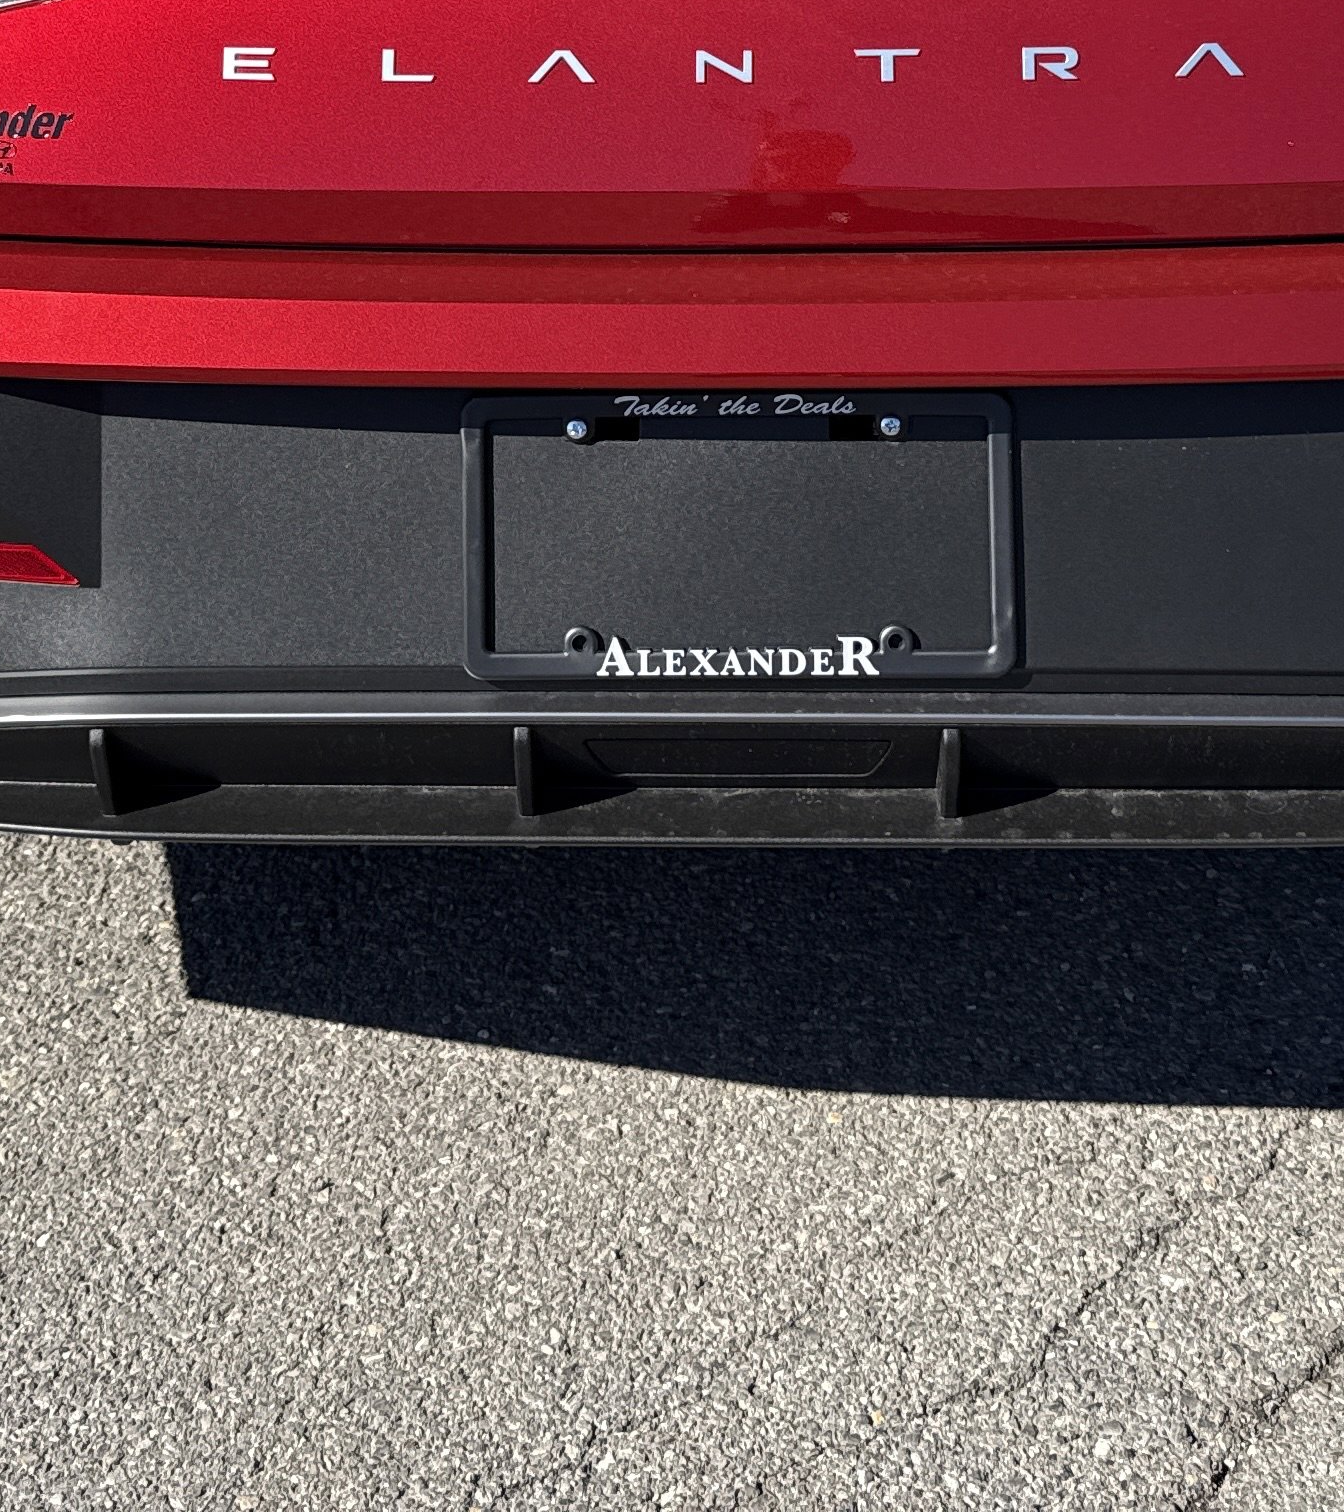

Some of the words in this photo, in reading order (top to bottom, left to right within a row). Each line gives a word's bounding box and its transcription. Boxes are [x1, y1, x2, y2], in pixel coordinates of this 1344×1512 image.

[221, 41, 1246, 85] ELANTRA
[613, 394, 709, 417] Takin'
[718, 394, 761, 416] the
[772, 393, 856, 416] Deals
